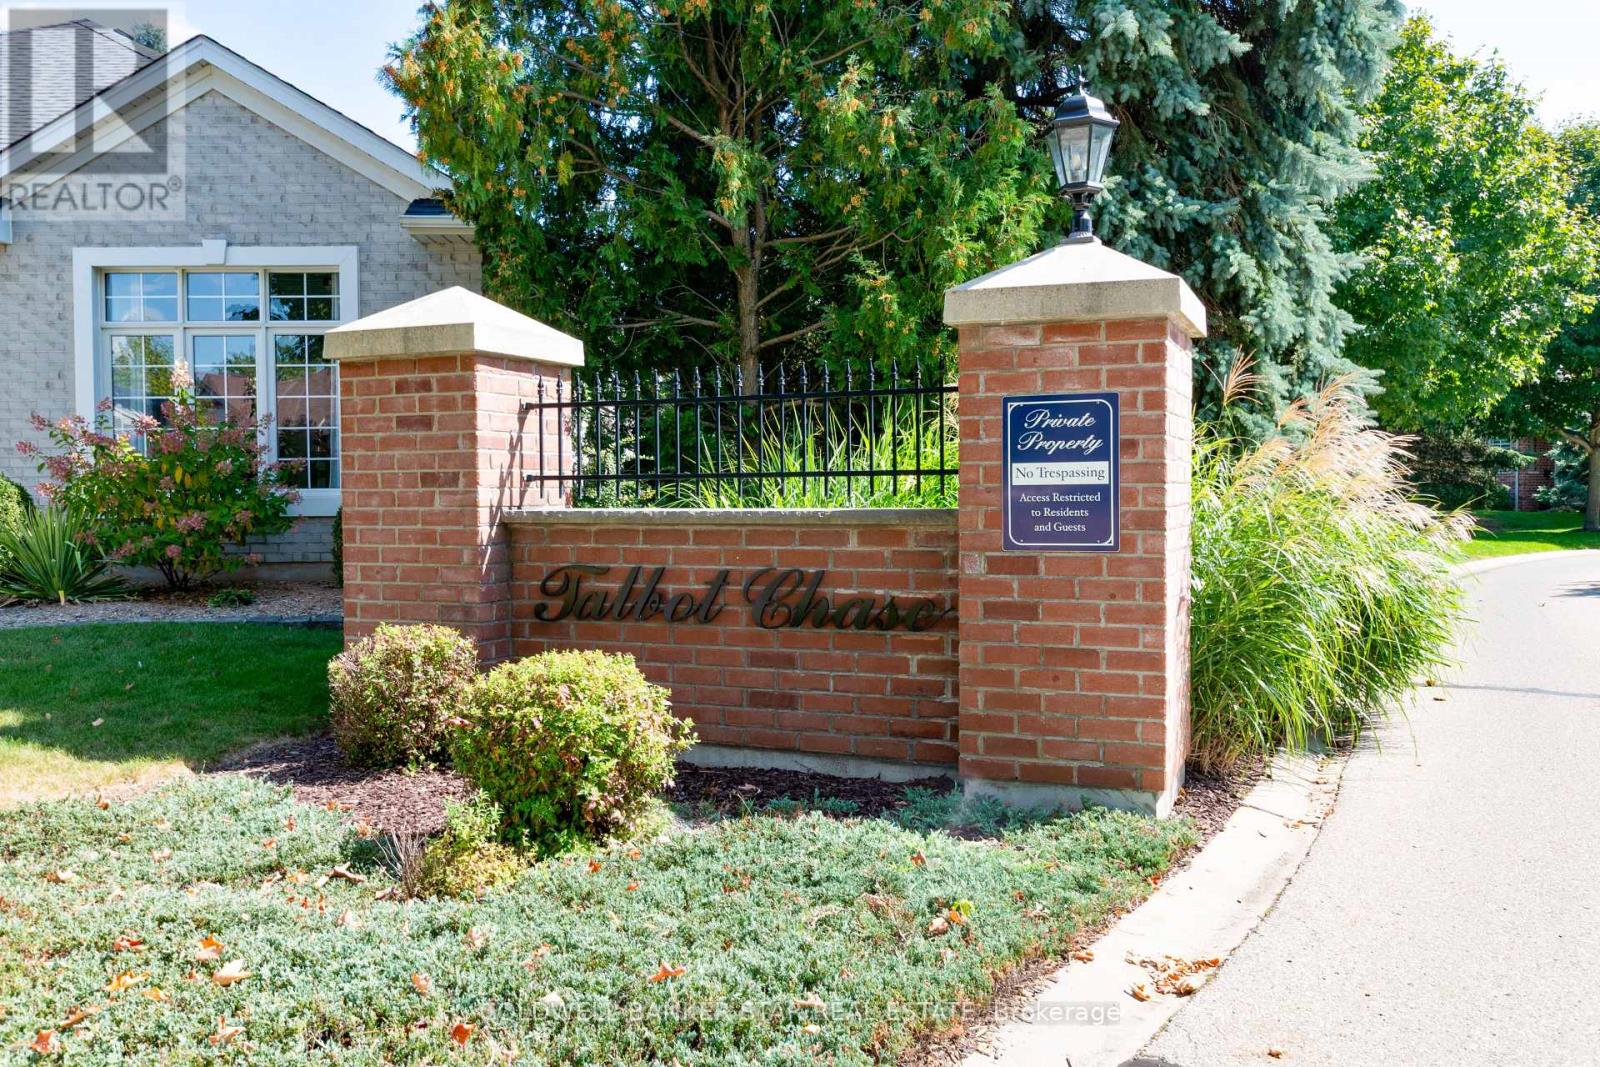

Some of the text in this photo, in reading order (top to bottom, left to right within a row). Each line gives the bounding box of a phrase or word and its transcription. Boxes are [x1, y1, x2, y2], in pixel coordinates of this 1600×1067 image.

[1024, 408, 1096, 429] Private
[1017, 431, 1103, 455] Property
[1015, 466, 1105, 481] No Trespassing
[1019, 492, 1101, 502] Access Restricted
[1031, 507, 1089, 517] to Residents
[1034, 522, 1086, 532] and Guests
[534, 565, 957, 632] Talbot Chase
